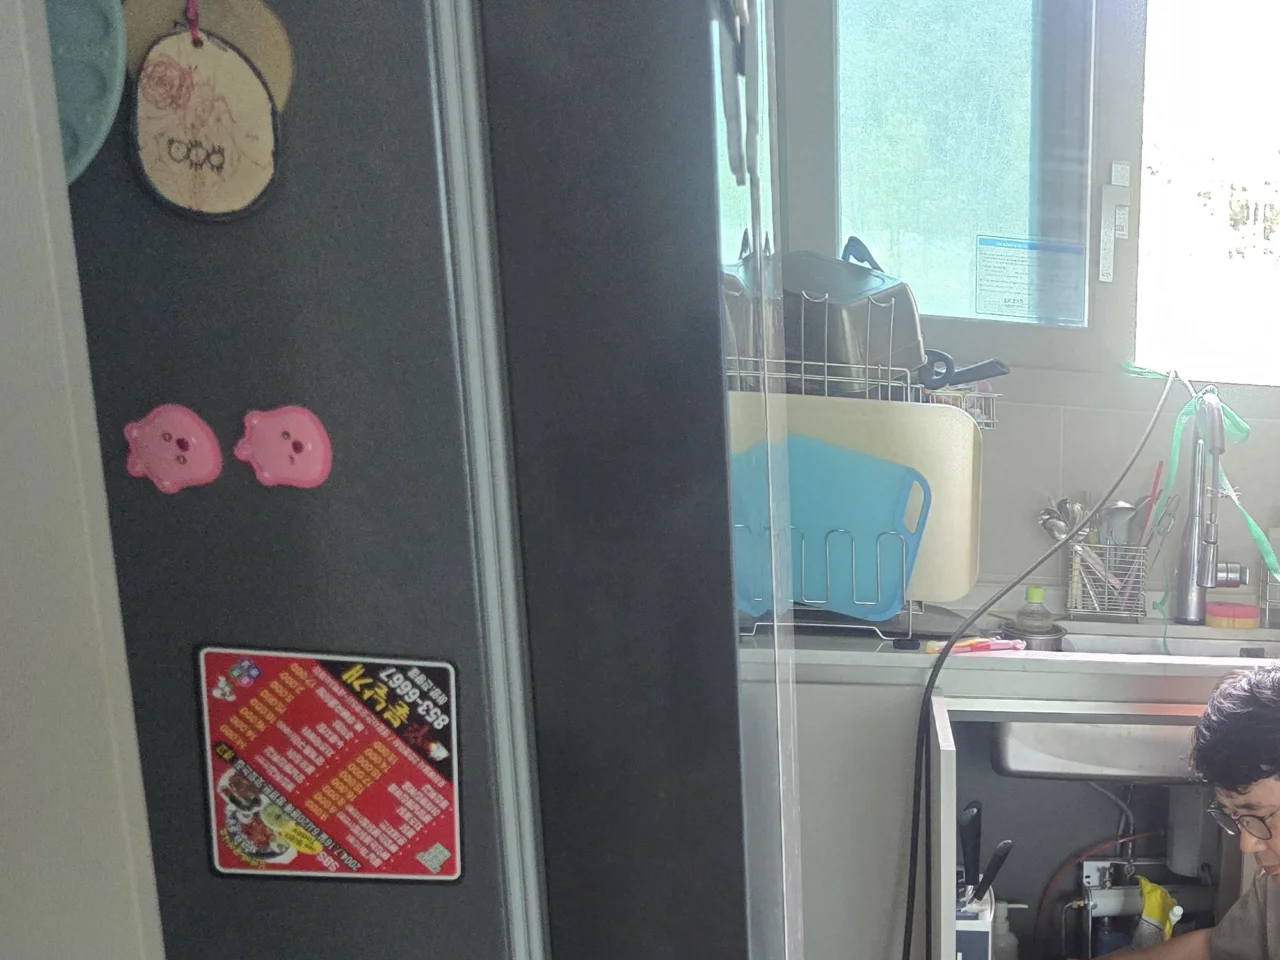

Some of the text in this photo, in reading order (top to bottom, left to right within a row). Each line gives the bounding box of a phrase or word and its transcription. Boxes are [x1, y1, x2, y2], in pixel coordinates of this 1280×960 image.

[339, 659, 416, 731] 불날개
[377, 663, 451, 731] 853-6667
[315, 849, 340, 873] SBS
